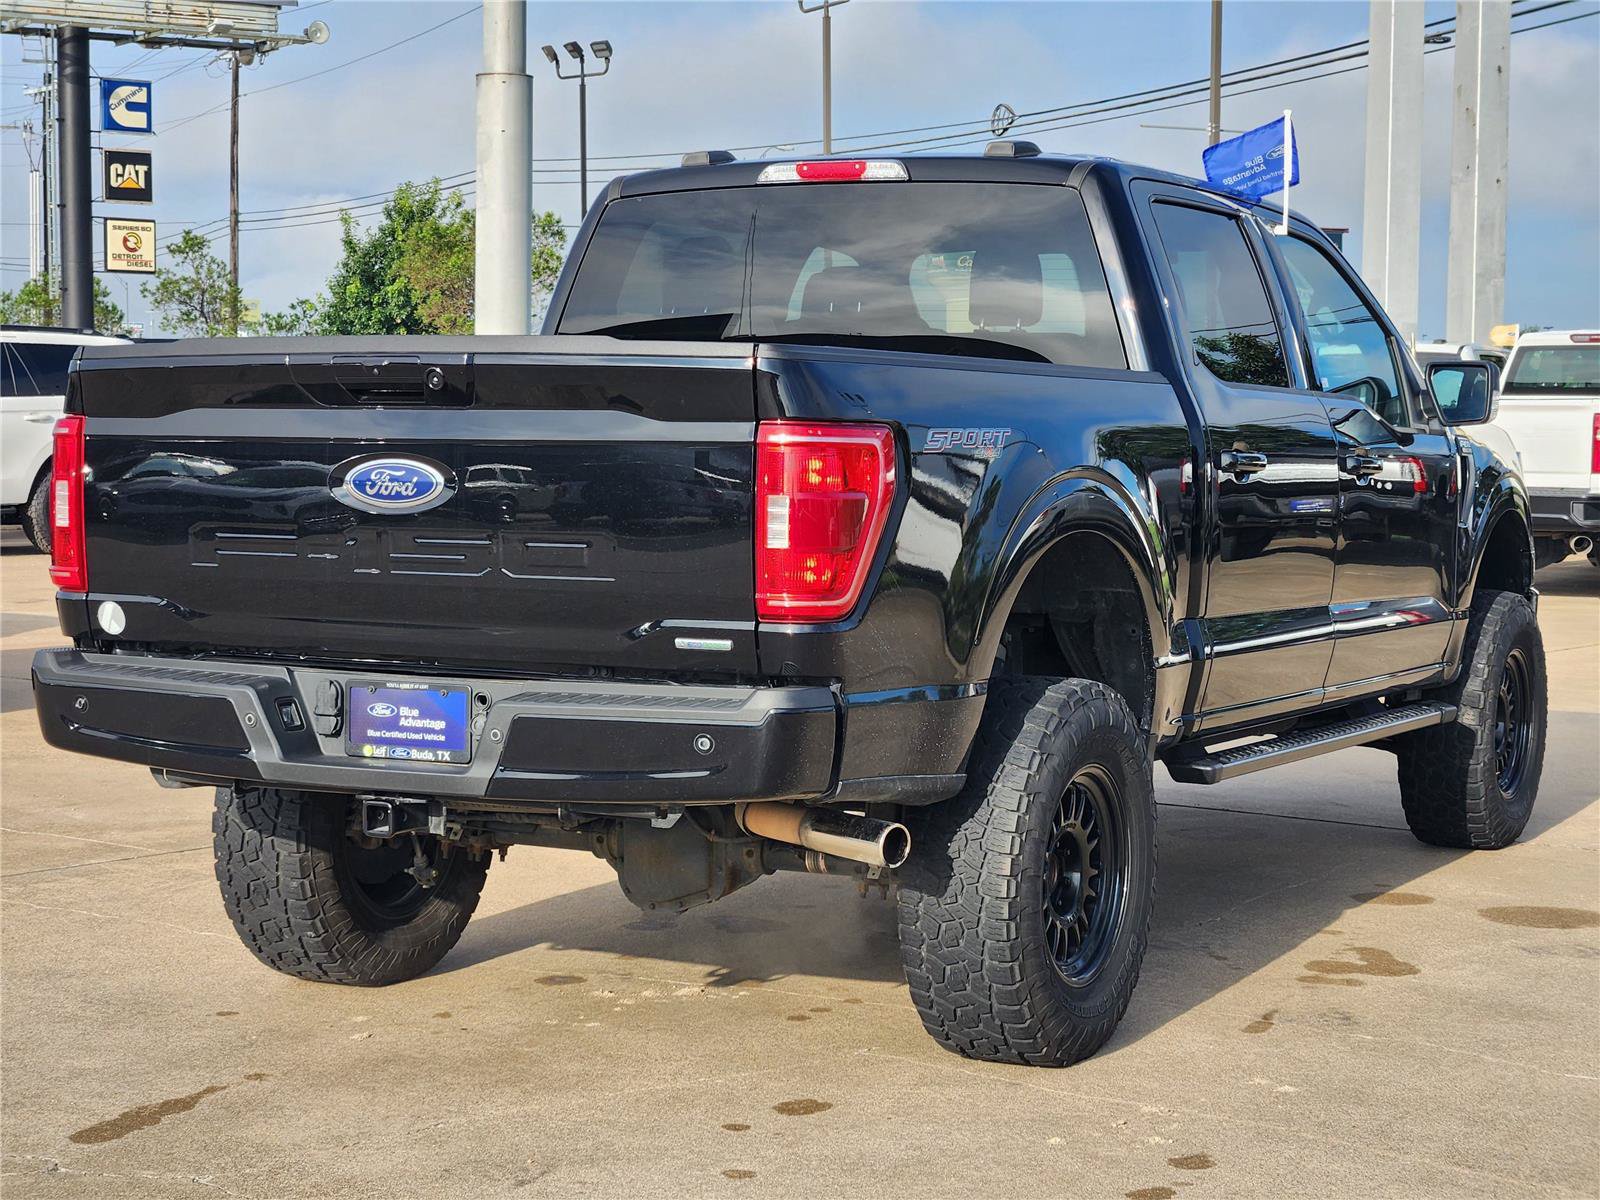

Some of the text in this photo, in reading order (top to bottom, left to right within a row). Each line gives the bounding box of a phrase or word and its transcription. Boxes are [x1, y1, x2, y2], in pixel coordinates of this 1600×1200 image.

[109, 86, 144, 112] Cummins
[110, 163, 149, 188] CAT
[923, 428, 1012, 453] SPORT
[365, 468, 418, 496] Ford
[400, 706, 419, 717] Blue
[399, 717, 446, 730] Advantage
[367, 729, 446, 742] Blue Certified Used Vehicle
[436, 750, 451, 761] TX
